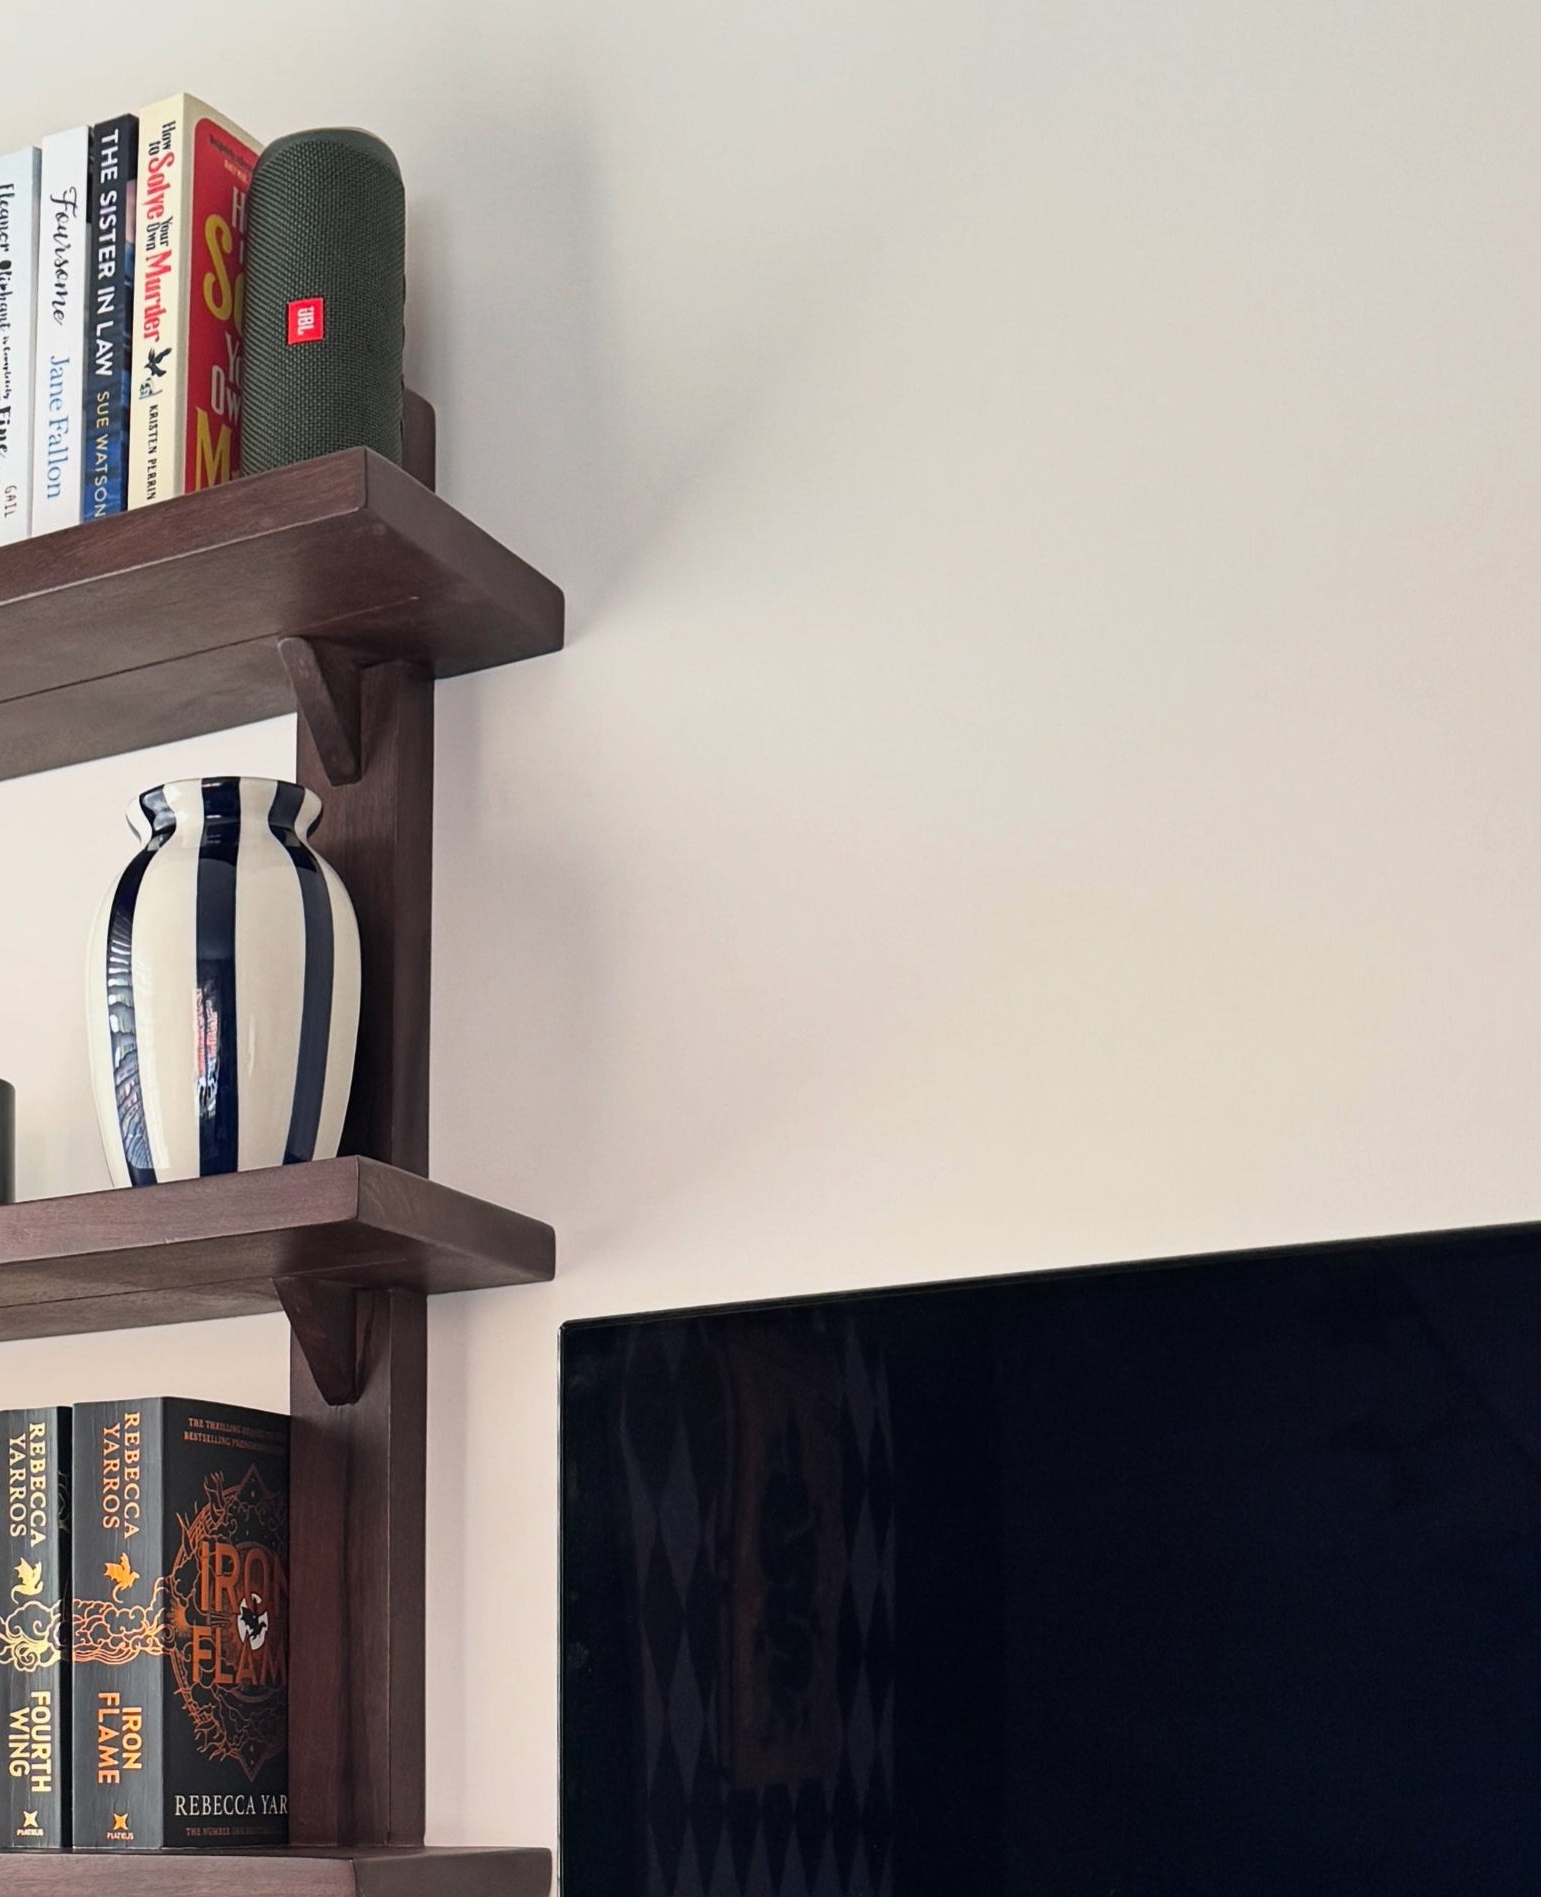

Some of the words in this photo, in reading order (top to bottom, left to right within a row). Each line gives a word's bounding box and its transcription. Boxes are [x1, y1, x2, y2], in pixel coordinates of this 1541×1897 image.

[99, 128, 119, 185] THE
[161, 120, 177, 151] How
[142, 151, 176, 221] Solve
[49, 185, 78, 327] Foursome
[97, 190, 118, 281] SISTER
[145, 220, 160, 253] Own
[159, 215, 174, 247] Your
[96, 285, 115, 315] IN
[143, 248, 173, 344] Murder
[297, 306, 315, 336] JBL
[95, 320, 114, 377] LAW
[48, 355, 71, 412] Jane
[96, 390, 110, 429] SUE
[46, 415, 69, 501] Fallon
[147, 404, 159, 456] KRISTEN
[3, 484, 18, 518] GAIL
[94, 433, 108, 519] WATSON
[146, 458, 158, 502] PERRIN
[8, 1432, 27, 1538] YARROS
[28, 1421, 48, 1548] REBECCA
[102, 1424, 121, 1530] YARROS
[122, 1411, 141, 1540] REBECCA
[200, 1540, 289, 1617] IRON
[192, 1625, 287, 1686] FLAM
[7, 1706, 30, 1778] WING
[30, 1690, 52, 1793] FOURTH
[97, 1692, 121, 1785] FLAME
[120, 1706, 143, 1770] IRON
[174, 1794, 256, 1816] REBECCA
